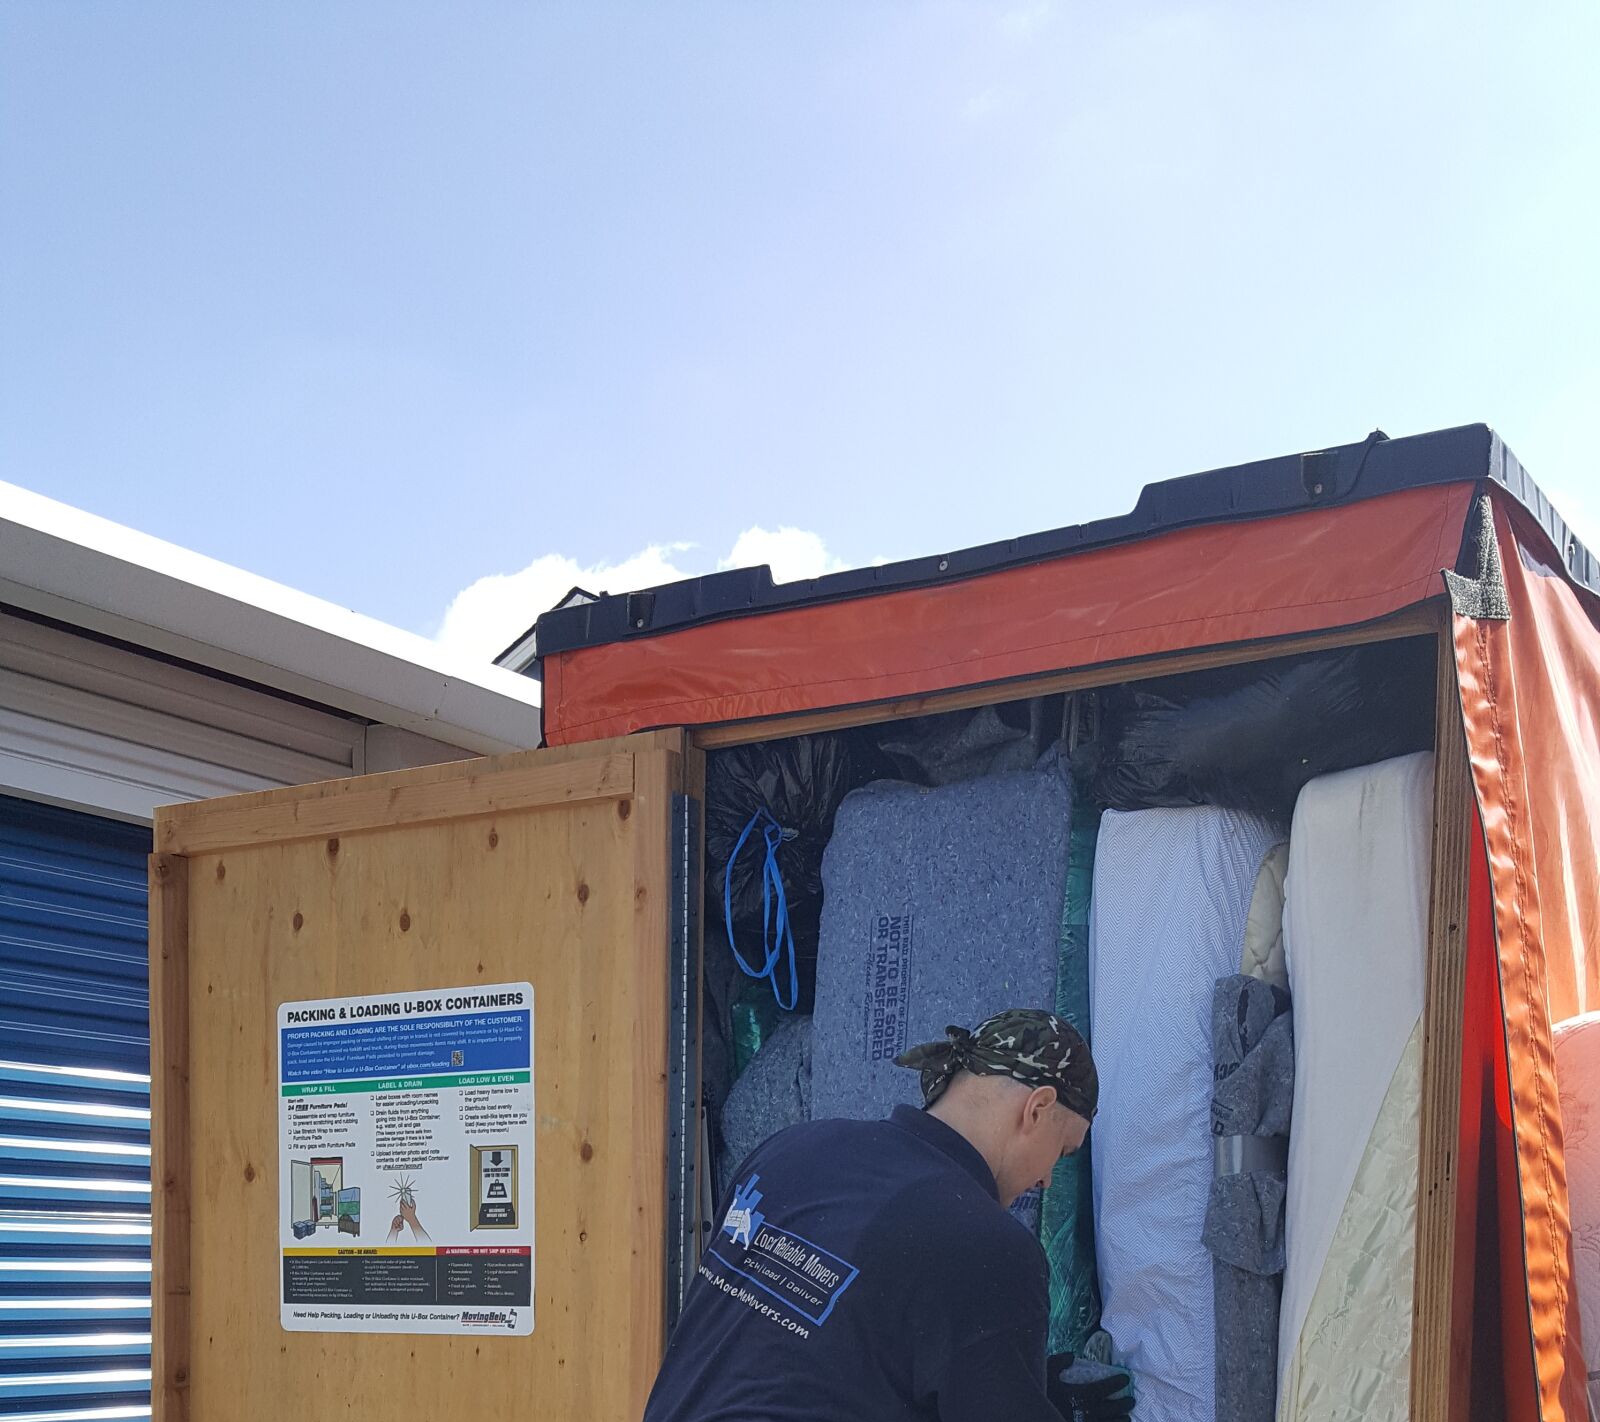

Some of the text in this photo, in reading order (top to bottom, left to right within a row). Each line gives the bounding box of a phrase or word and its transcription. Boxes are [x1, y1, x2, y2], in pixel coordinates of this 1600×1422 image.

[871, 916, 889, 1061] OR TRANSFERRED
[883, 916, 901, 1059] NOT TO BE SOLD
[288, 1008, 335, 1023] PACKING
[339, 1007, 346, 1019] &
[350, 1003, 400, 1018] LOADING
[446, 993, 523, 1011] CONTAINERS
[287, 1032, 309, 1040] PROPER
[311, 1030, 334, 1038] PACKING
[349, 1027, 373, 1035] LOADING
[400, 1024, 415, 1032] SOLE
[416, 1021, 463, 1030] RESPONSIBILITY
[773, 1236, 806, 1268] Reliable
[801, 1254, 840, 1289] Movers
[786, 1280, 824, 1308] Deliver
[372, 1312, 398, 1320] Unloading
[430, 1313, 460, 1321] Container?
[462, 1312, 506, 1323] MovingHelp
